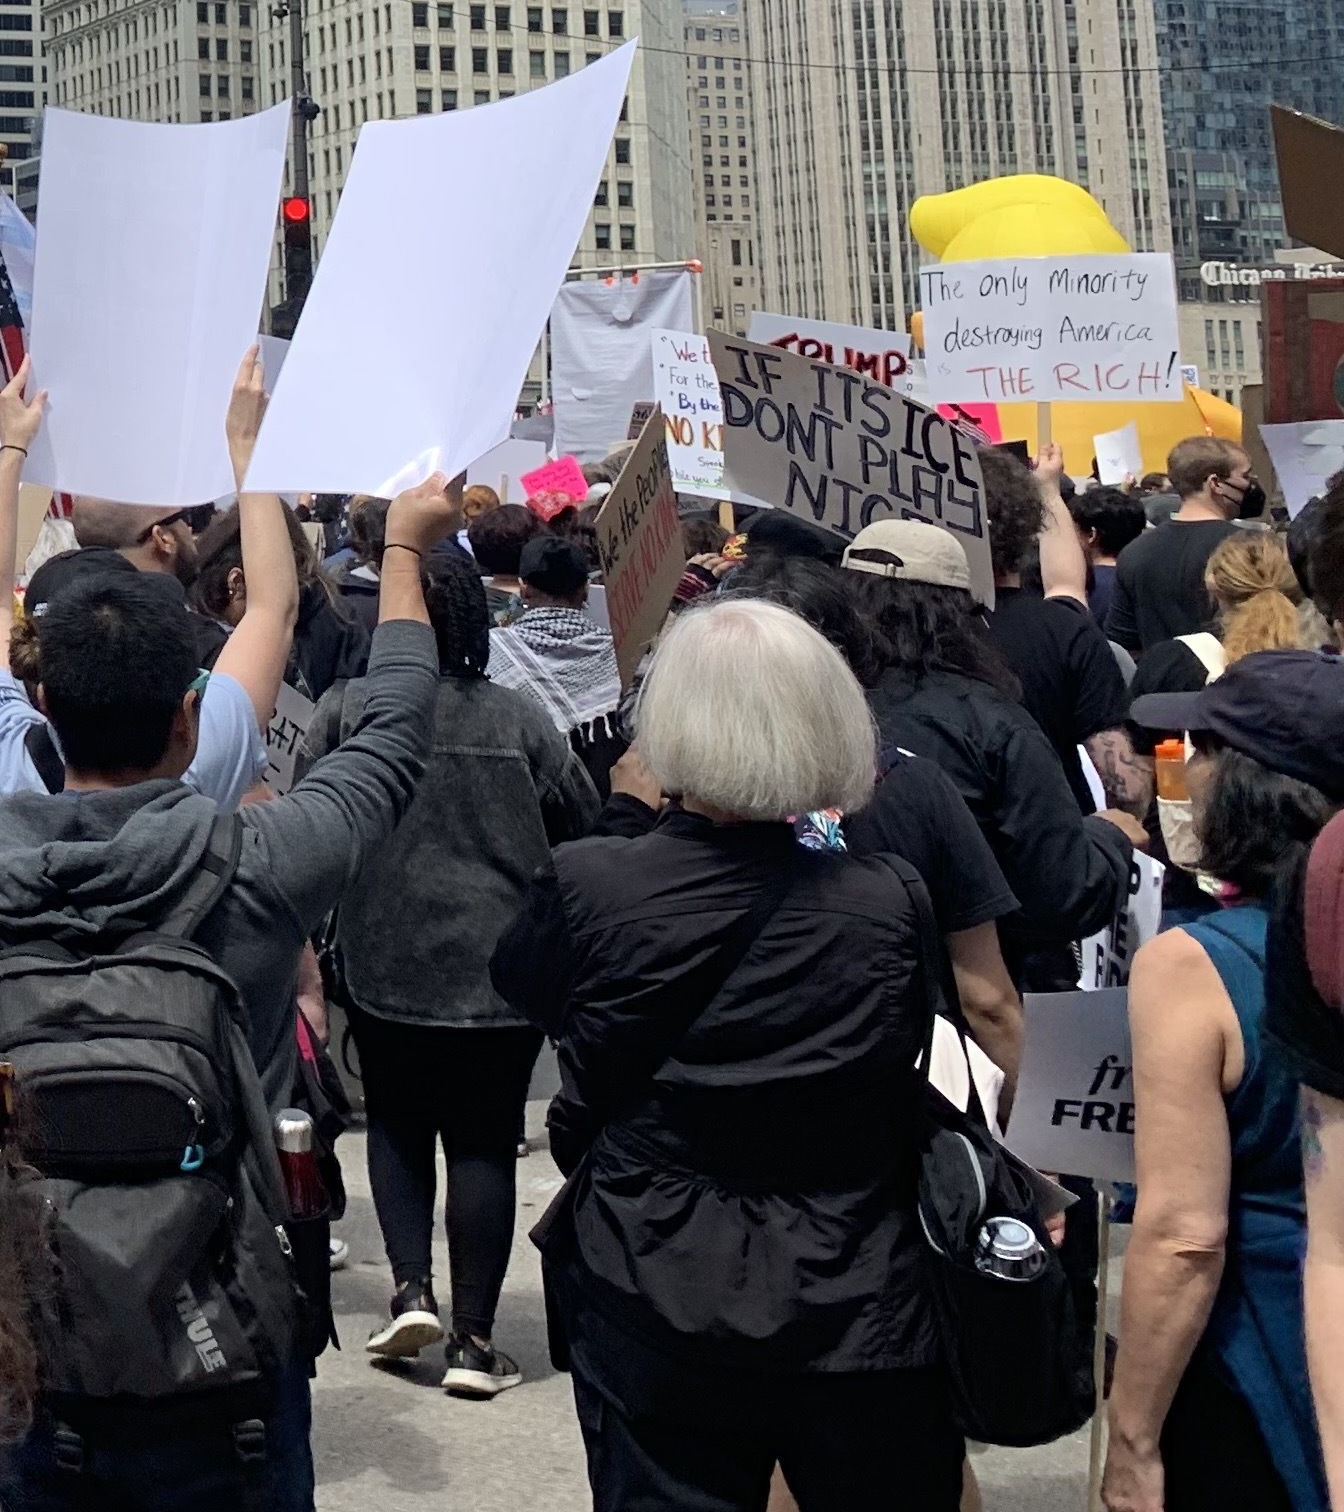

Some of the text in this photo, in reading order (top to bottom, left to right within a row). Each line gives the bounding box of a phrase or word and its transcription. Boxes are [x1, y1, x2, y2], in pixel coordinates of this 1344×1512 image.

[921, 271, 964, 306] The
[1050, 268, 1149, 301] Minority
[944, 316, 1153, 353] destroying America
[669, 366, 718, 391] For the
[965, 366, 1035, 399] THE
[1052, 351, 1178, 395] RICH!
[678, 392, 720, 415] By the
[725, 345, 782, 394] IF
[900, 399, 979, 490] ICE
[662, 412, 695, 447] NO
[858, 434, 983, 538] PLAY
